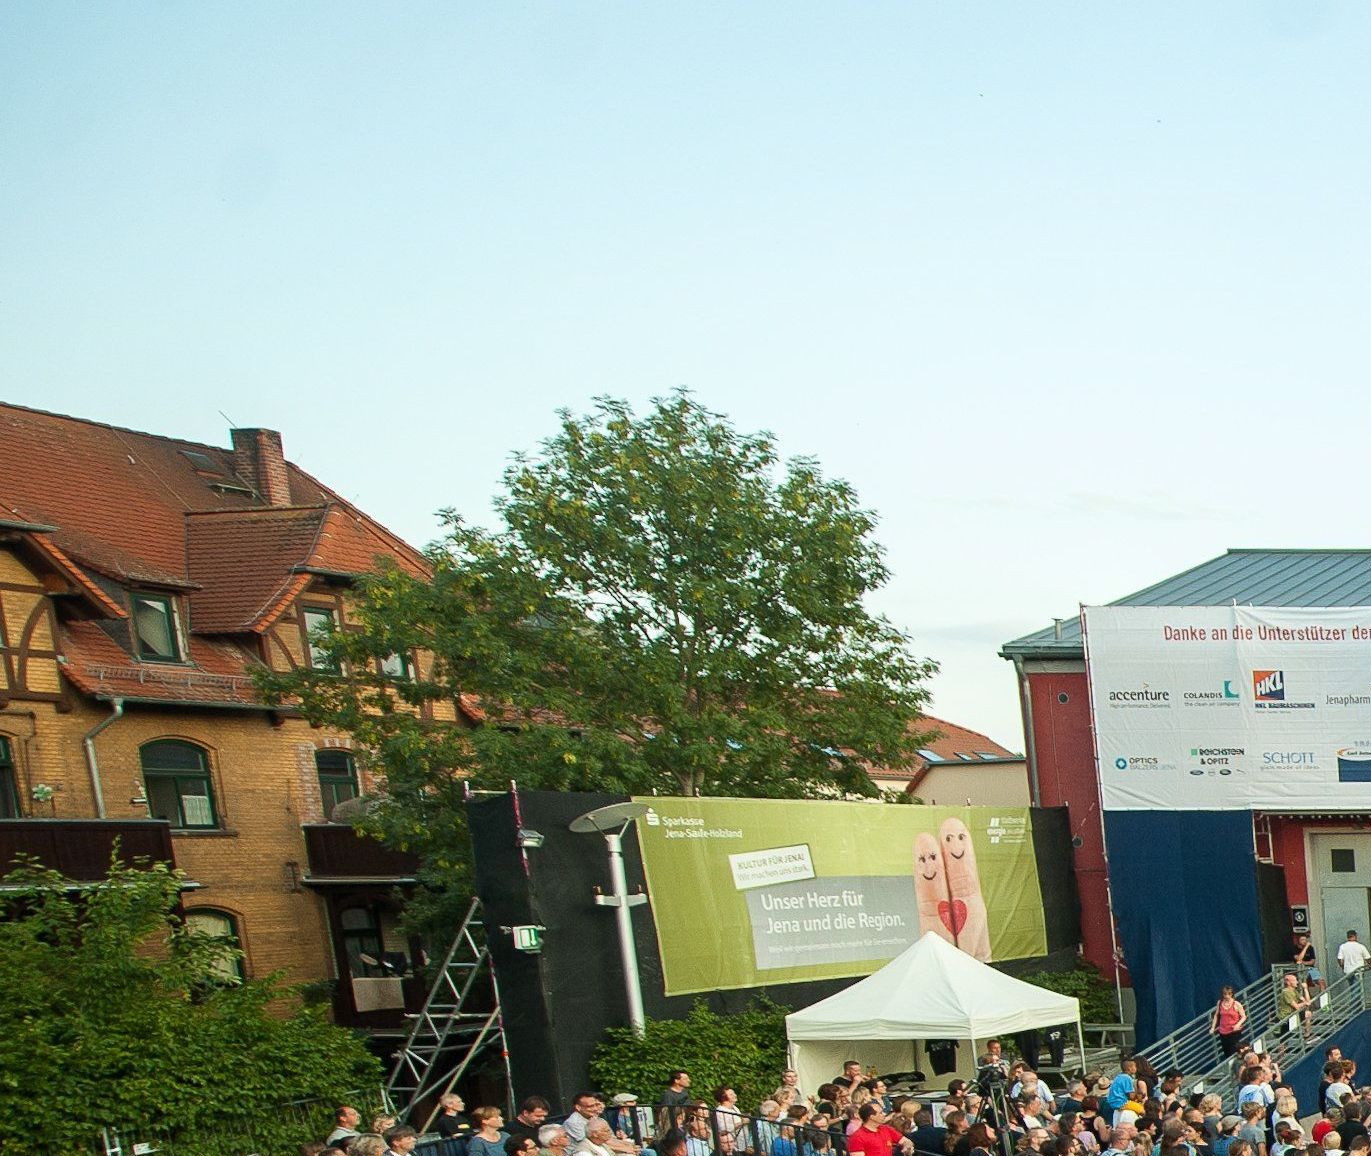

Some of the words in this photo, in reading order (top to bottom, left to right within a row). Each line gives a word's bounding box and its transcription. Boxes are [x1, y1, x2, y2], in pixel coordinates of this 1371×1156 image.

[1163, 625, 1206, 641] Danke
[1211, 628, 1228, 641] an
[1232, 625, 1253, 640] die
[1257, 624, 1347, 641] Unterstützer
[1256, 670, 1283, 697] HKL
[1109, 688, 1170, 702] accenture
[1325, 694, 1371, 707] Jenapharm
[1207, 757, 1230, 765] OPITZ
[1262, 751, 1315, 764] SCHOTT
[661, 816, 705, 827] Sparkasse
[665, 828, 743, 839] Jena-Saale-Holzland
[737, 855, 767, 869] KULTUR
[768, 854, 784, 866] FÜR
[784, 852, 805, 864] JENA!
[738, 871, 751, 881] Wir
[751, 868, 779, 880] machen
[780, 868, 792, 876] uns
[793, 864, 809, 874] stark.
[760, 893, 806, 911] Unser
[806, 891, 842, 909] Herz
[842, 890, 865, 907] für
[766, 916, 800, 934] Jena
[803, 913, 832, 932] und
[833, 912, 856, 930] die
[858, 911, 905, 932] Region.
